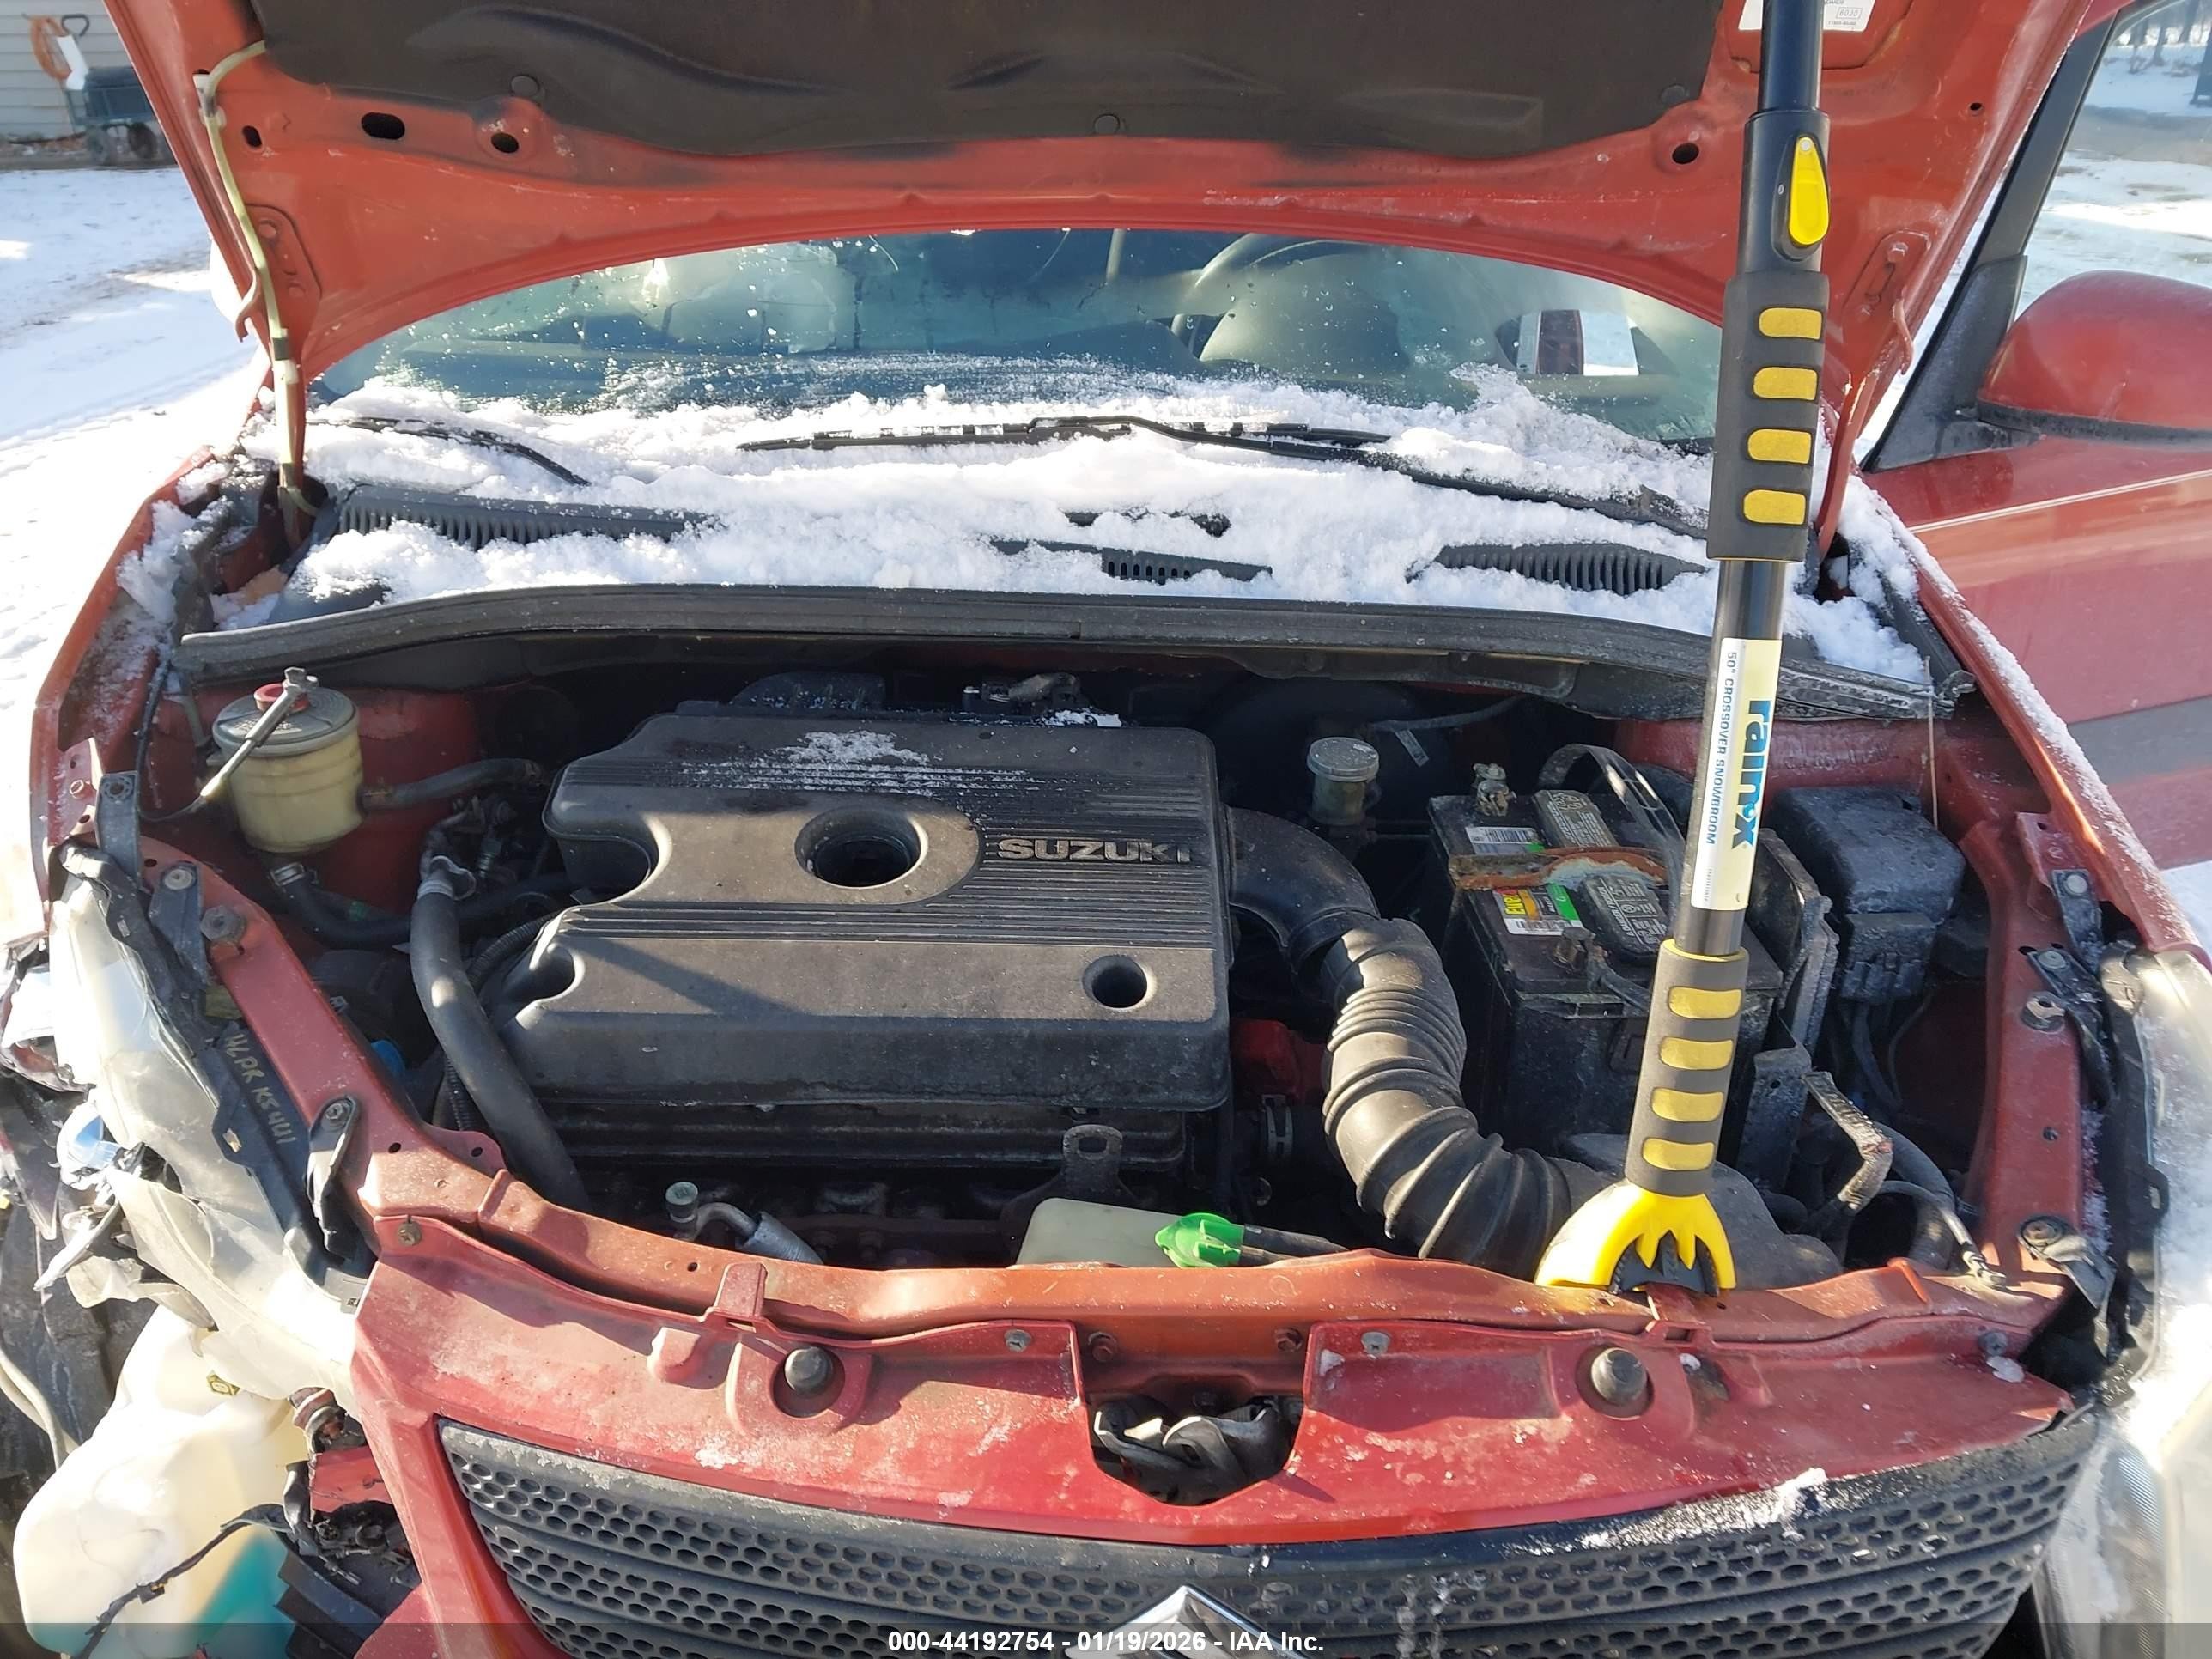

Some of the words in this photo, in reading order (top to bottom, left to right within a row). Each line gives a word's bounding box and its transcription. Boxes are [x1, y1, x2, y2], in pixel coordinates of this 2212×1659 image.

[1717, 678, 1734, 755] CROSSOVER
[1705, 759, 1725, 845] SNOWBROOM
[998, 838, 1191, 863] SUZUKI
